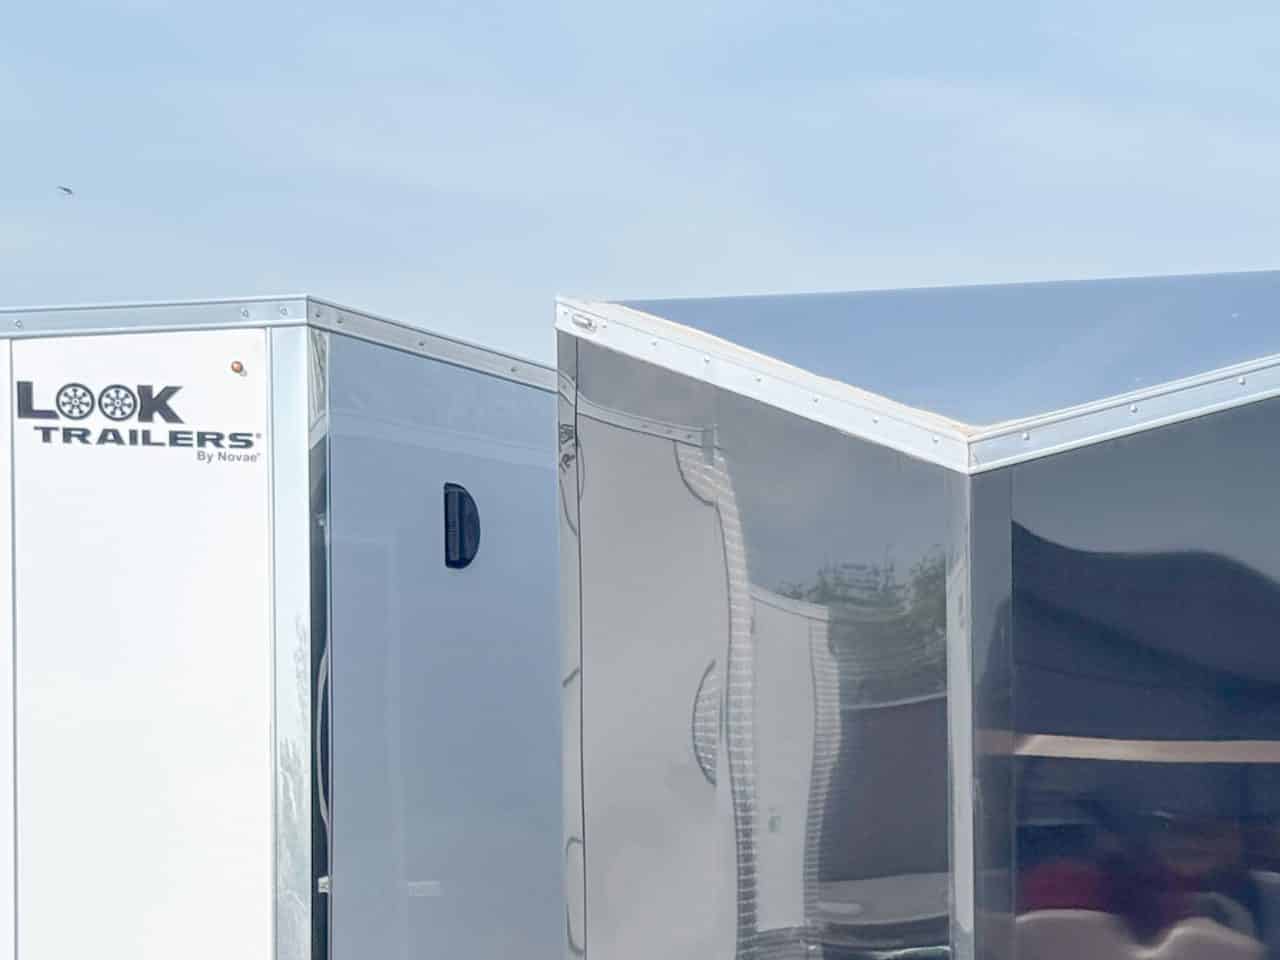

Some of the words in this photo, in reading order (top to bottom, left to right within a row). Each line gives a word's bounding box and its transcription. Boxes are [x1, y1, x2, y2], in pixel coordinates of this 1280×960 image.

[16, 380, 185, 424] LOOK
[33, 426, 256, 449] TRAILERS
[196, 450, 214, 464] By
